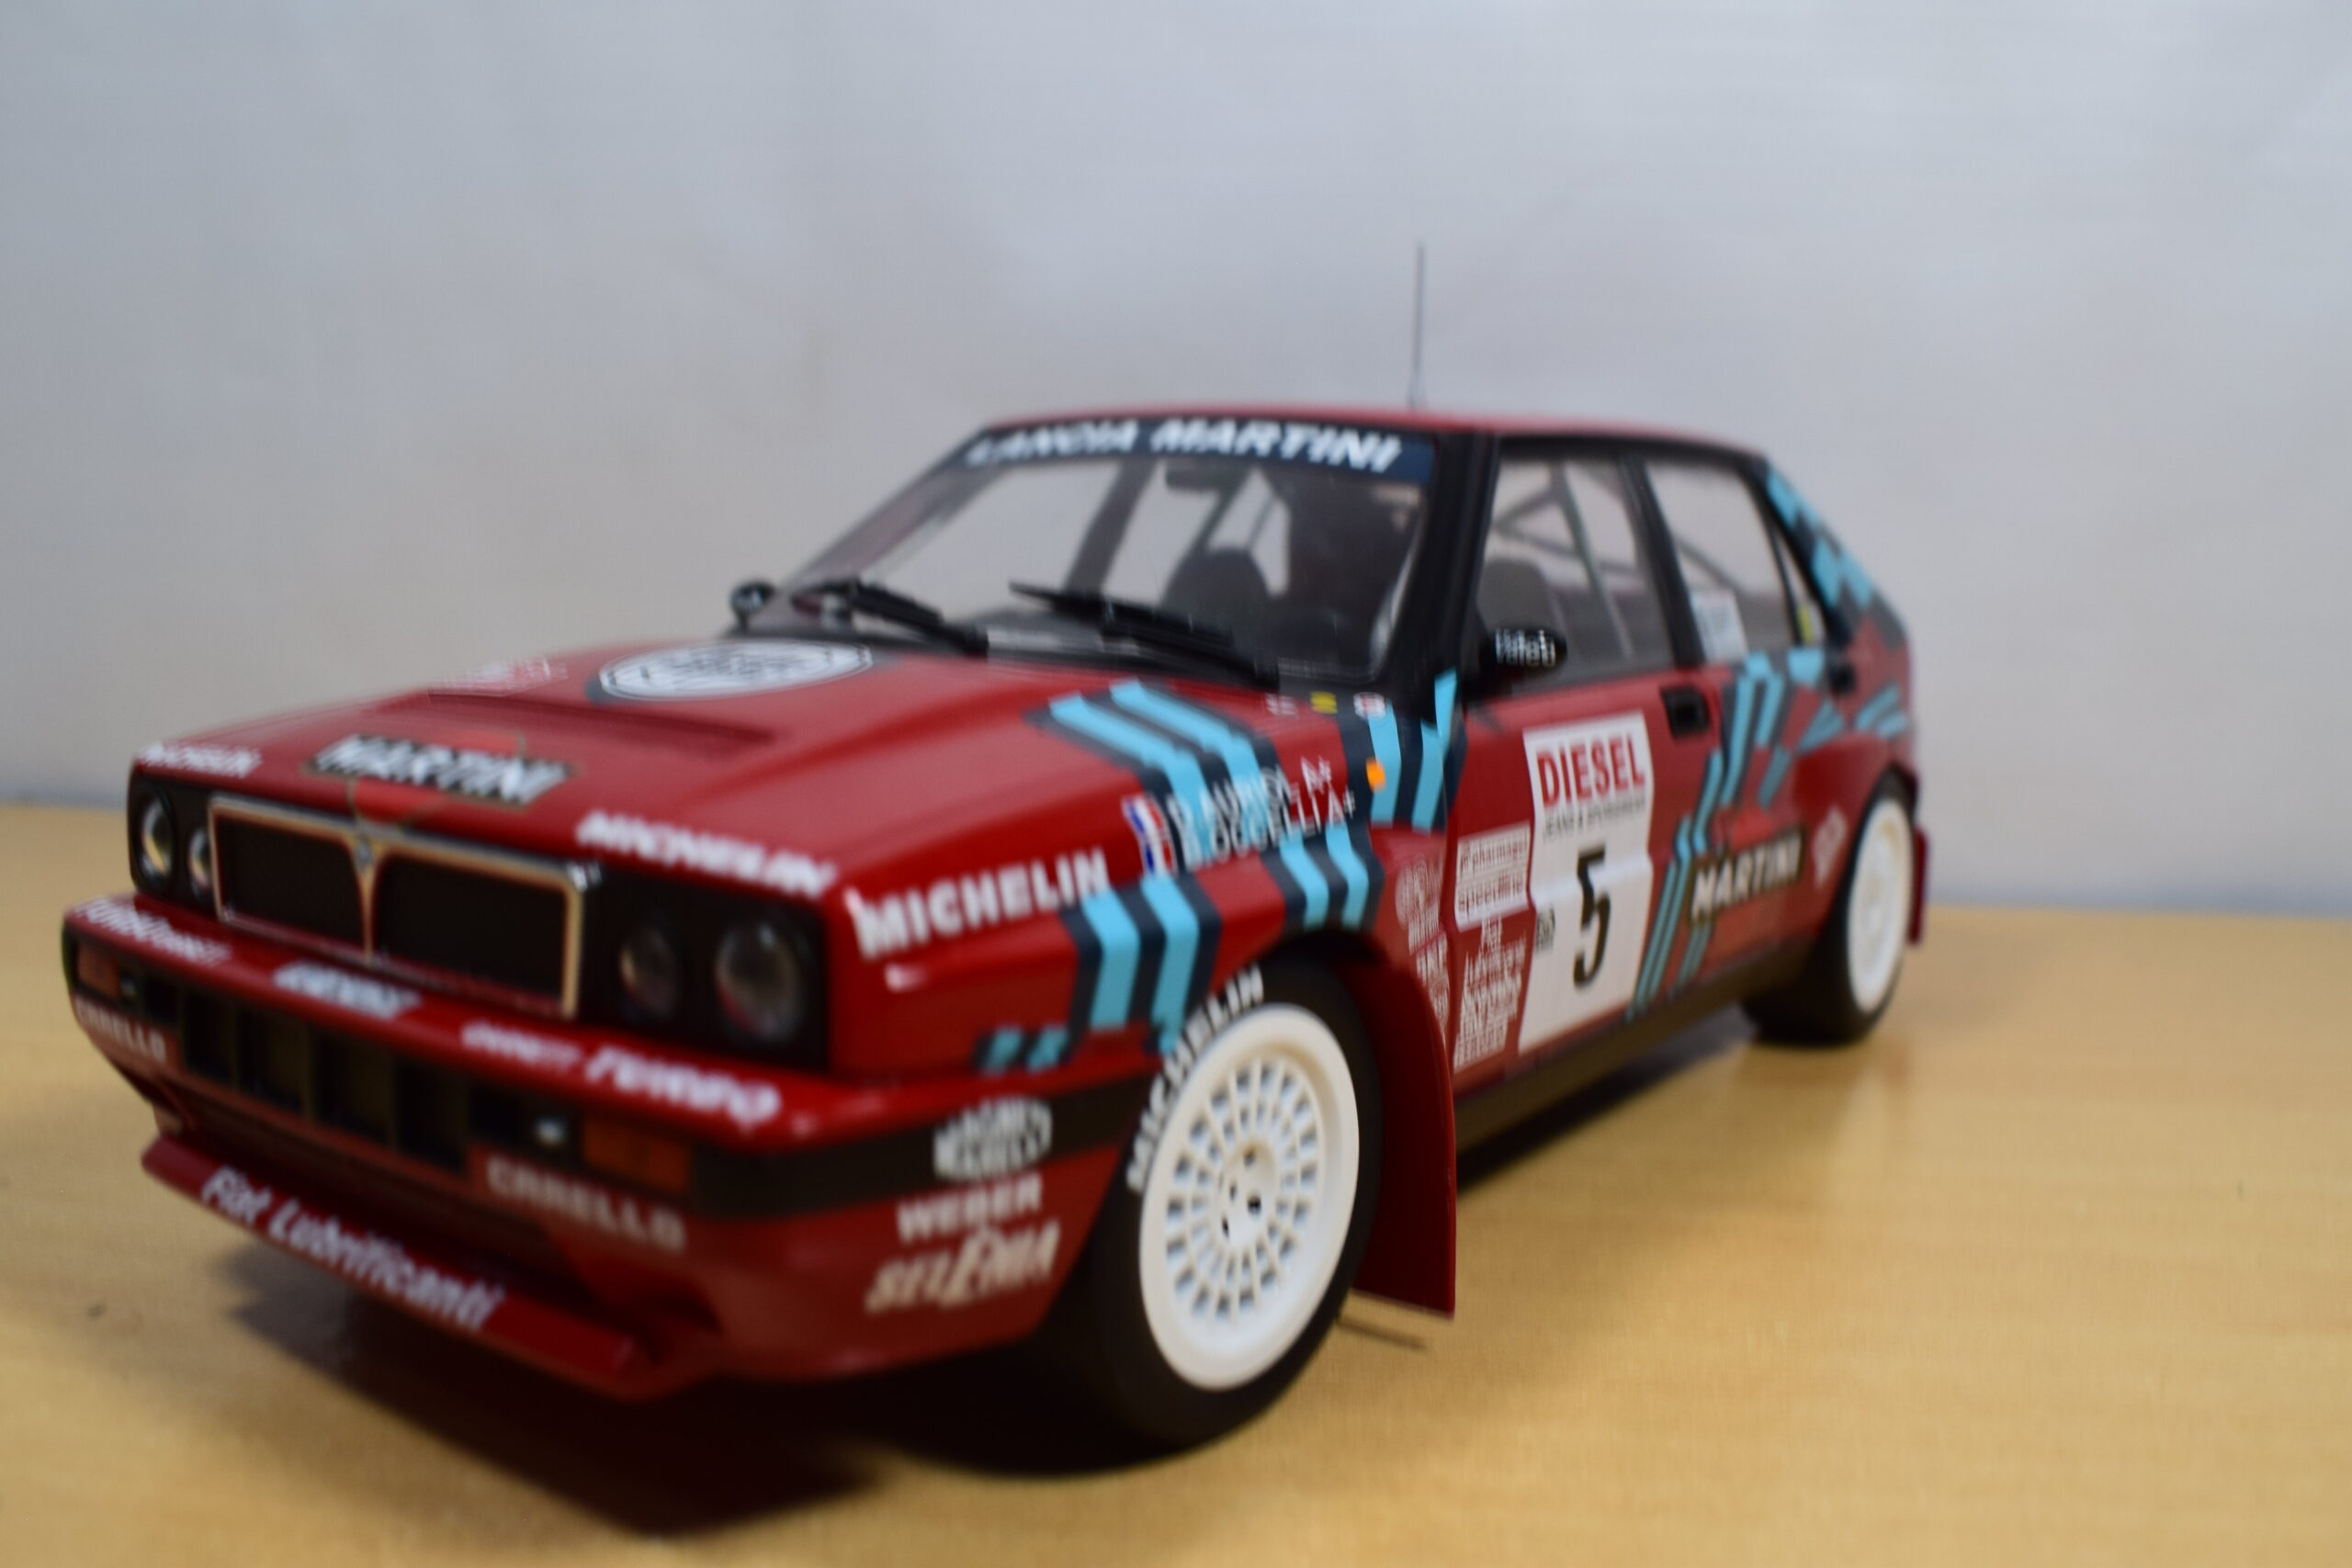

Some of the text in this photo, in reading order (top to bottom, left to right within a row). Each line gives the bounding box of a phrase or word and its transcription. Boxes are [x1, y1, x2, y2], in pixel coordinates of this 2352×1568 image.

[966, 418, 1403, 473] LANCIA MARTINI
[1535, 731, 1646, 810] DIESEL
[842, 847, 1113, 961] MICHELIN
[1572, 842, 1612, 990] 5
[1690, 832, 1804, 922] MARTINI
[199, 1162, 274, 1229] Fiat
[895, 1168, 1045, 1246] WEBER
